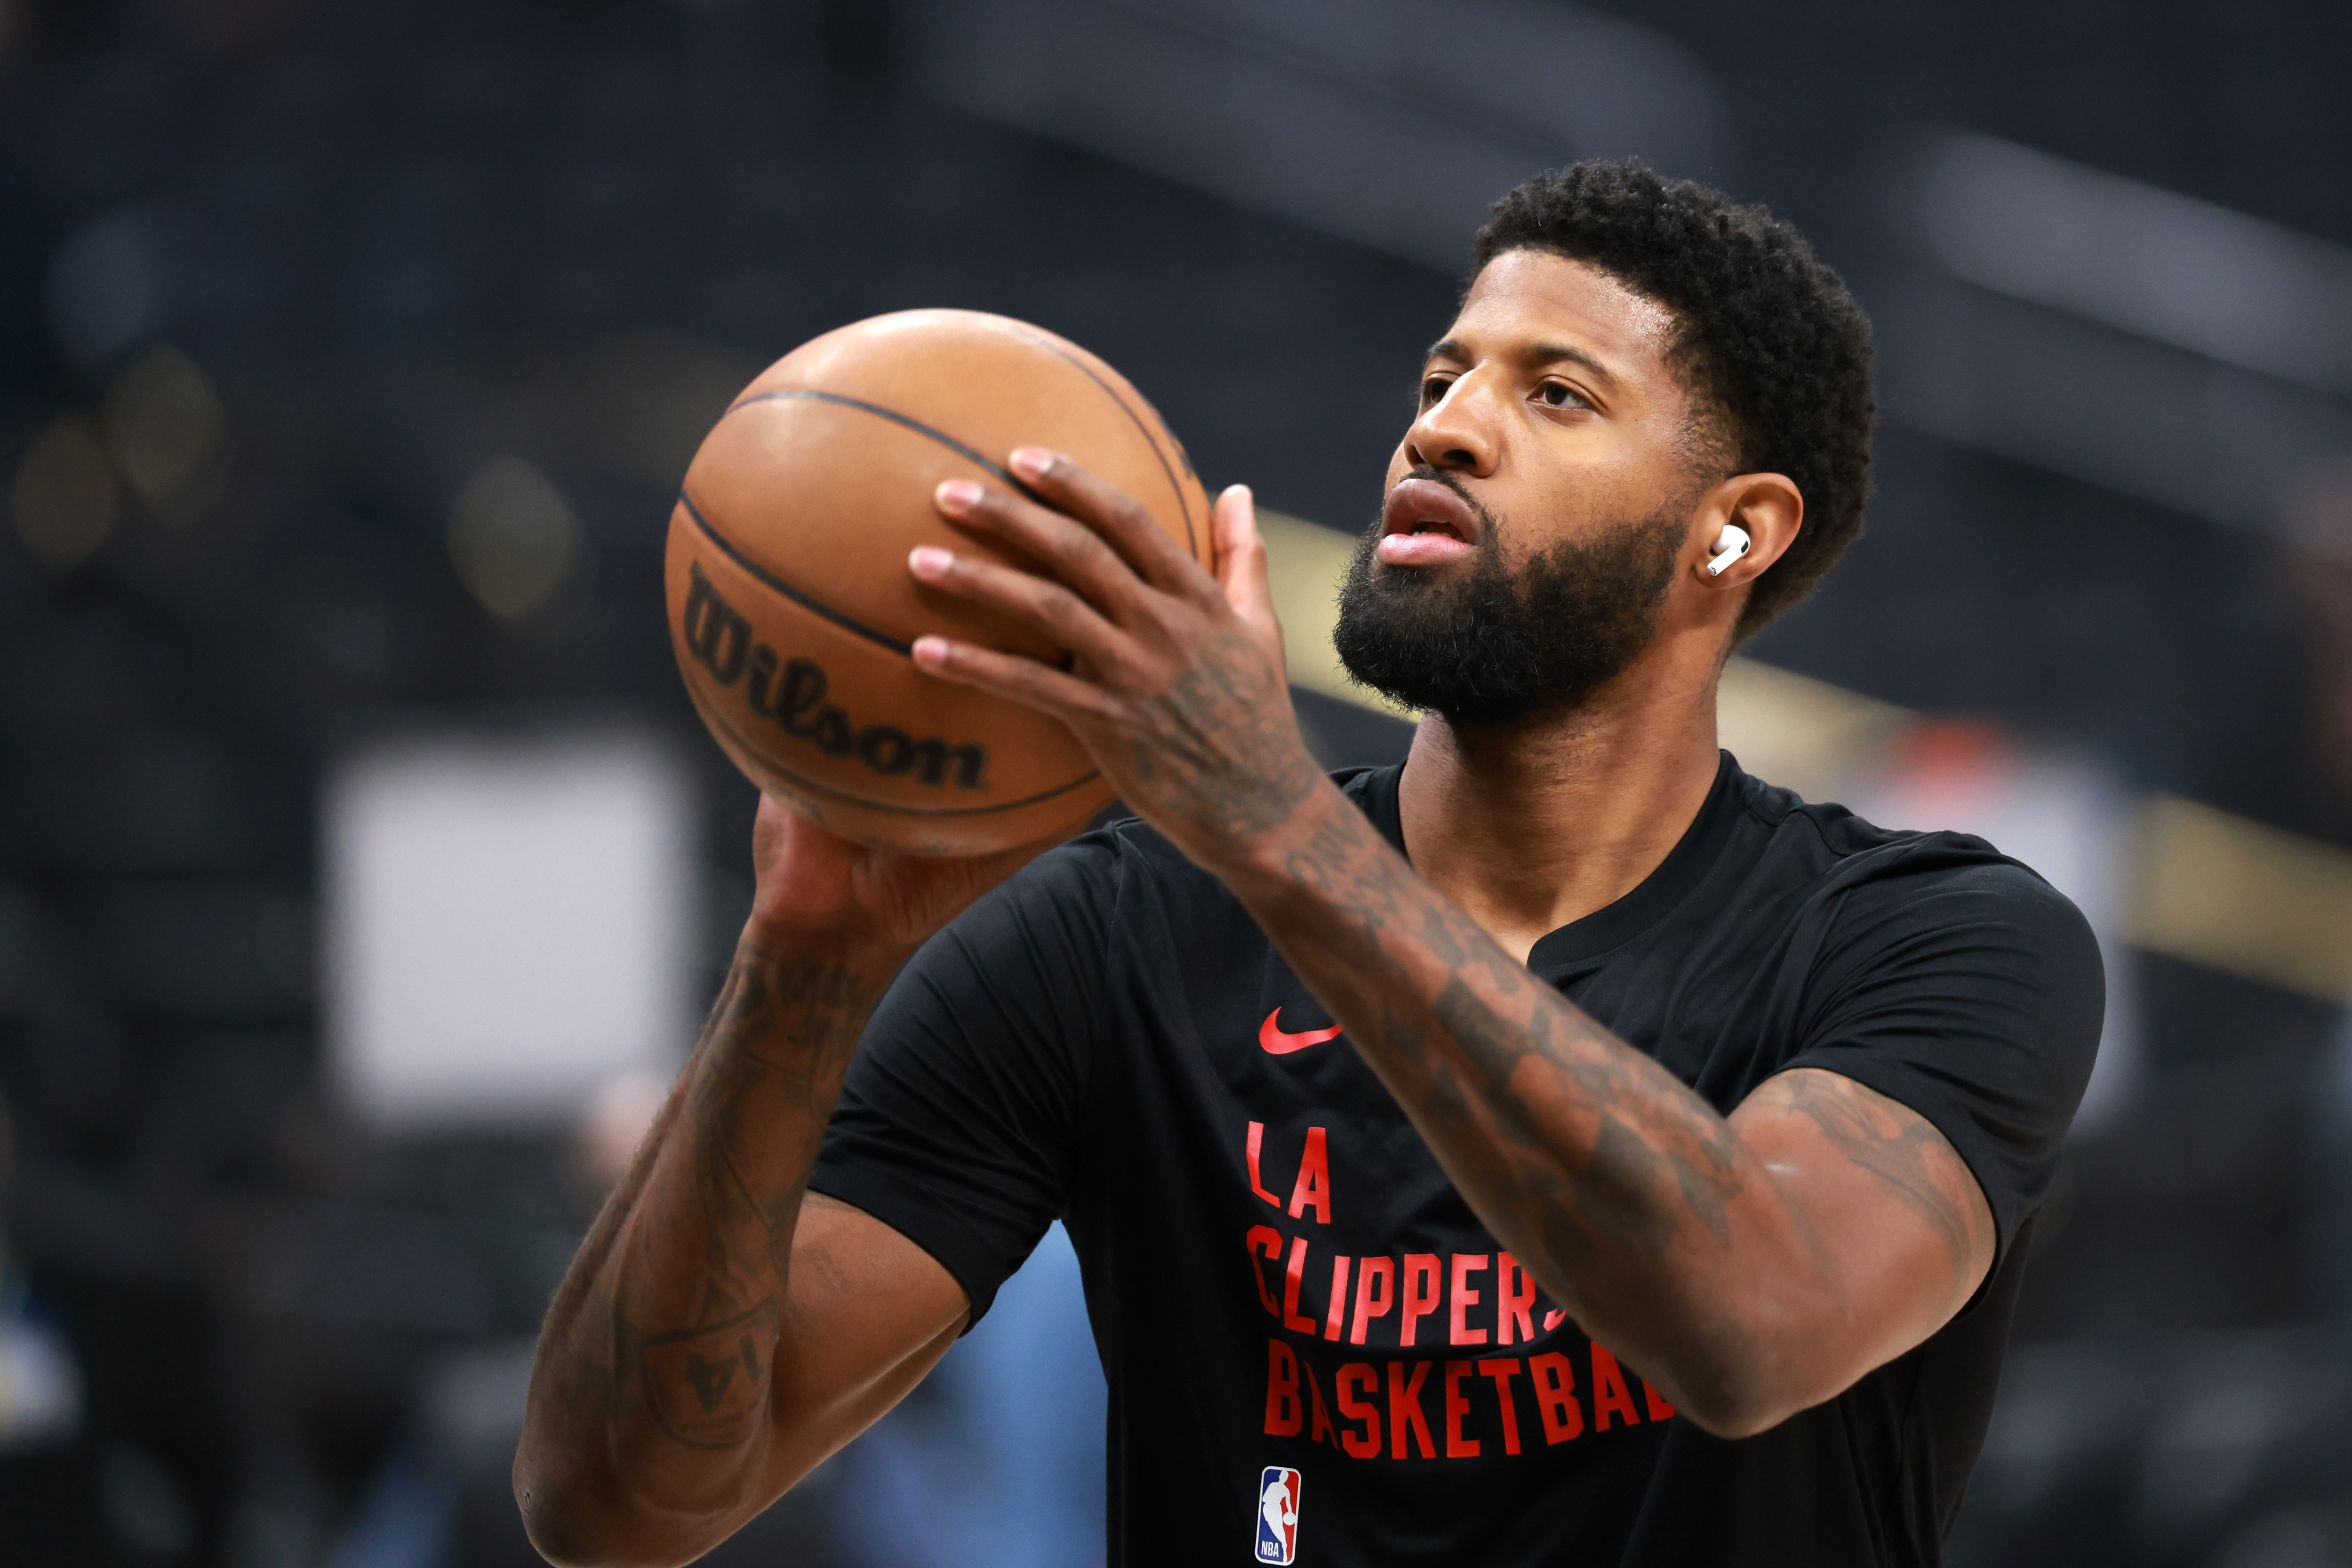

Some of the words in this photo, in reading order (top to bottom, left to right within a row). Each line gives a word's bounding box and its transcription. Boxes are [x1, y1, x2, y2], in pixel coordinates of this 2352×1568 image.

[684, 559, 988, 788] Wilson
[1246, 1121, 1331, 1224] LA
[1246, 1225, 1566, 1346] CLIPPER
[1264, 1337, 1676, 1460] BASKETBAL
[1261, 1540, 1279, 1557] NBA
